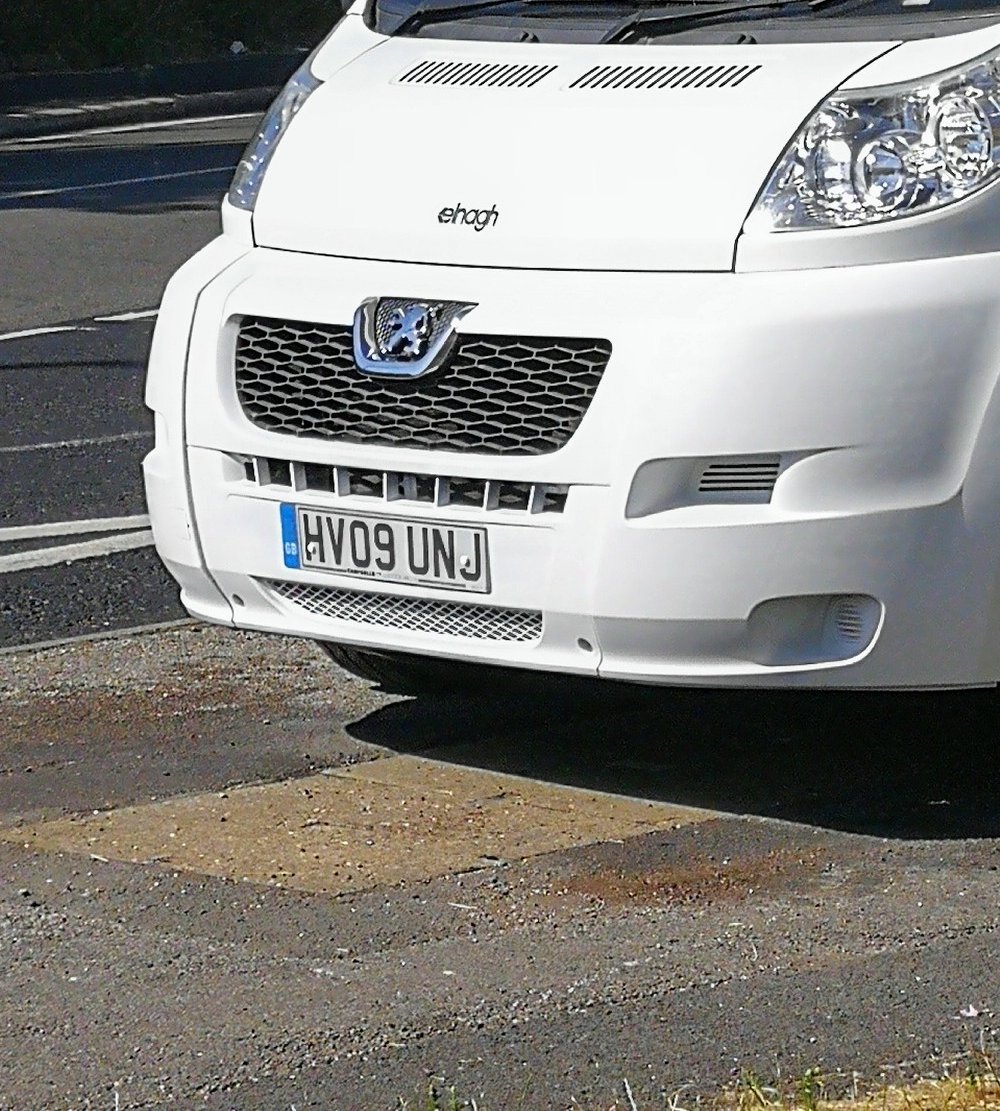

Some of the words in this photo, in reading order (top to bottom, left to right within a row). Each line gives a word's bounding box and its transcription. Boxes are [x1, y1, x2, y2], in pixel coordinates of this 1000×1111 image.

[284, 541, 298, 556] GB
[302, 513, 396, 572] HV09
[407, 526, 481, 582] UNJ
